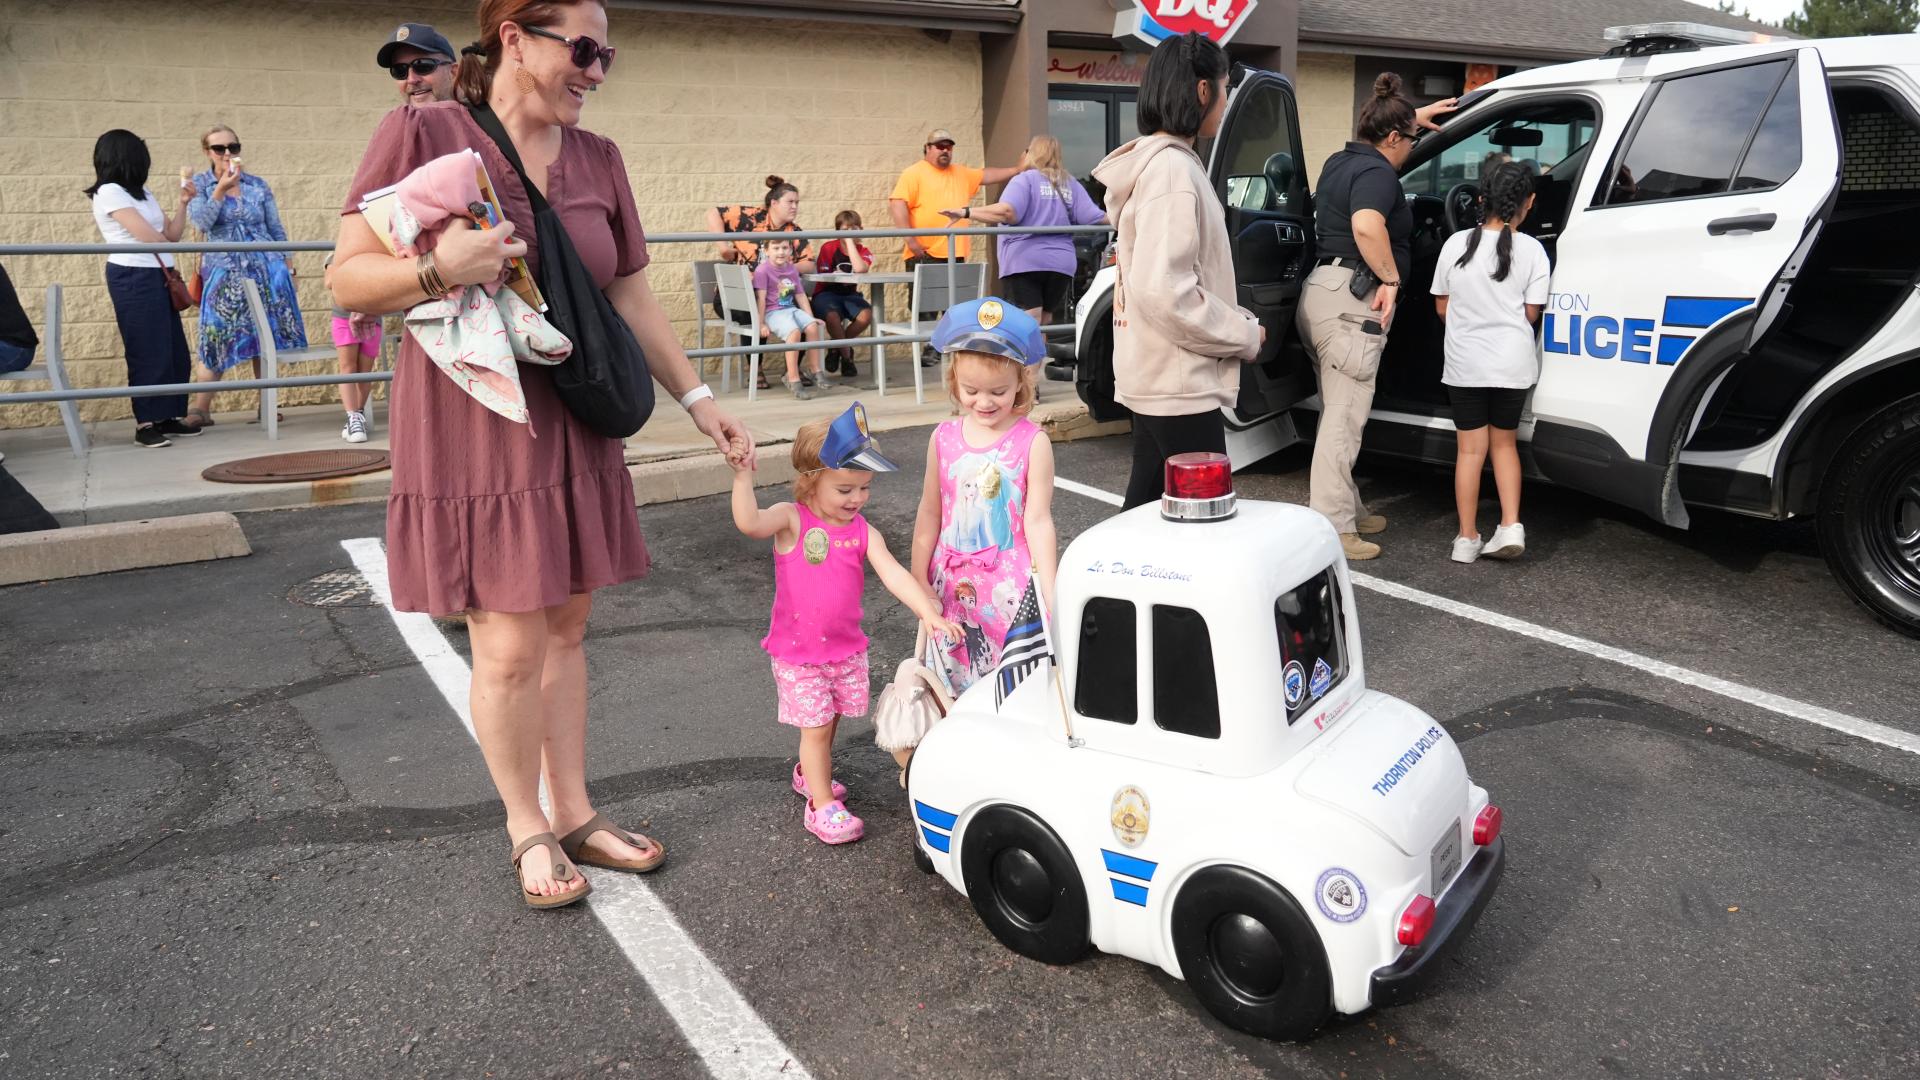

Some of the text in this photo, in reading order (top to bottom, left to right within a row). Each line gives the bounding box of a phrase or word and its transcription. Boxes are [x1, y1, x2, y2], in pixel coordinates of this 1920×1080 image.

[1543, 312, 1656, 365] LICE
[1111, 561, 1136, 576] Don
[1372, 726, 1444, 797] THORNTON POLICE
